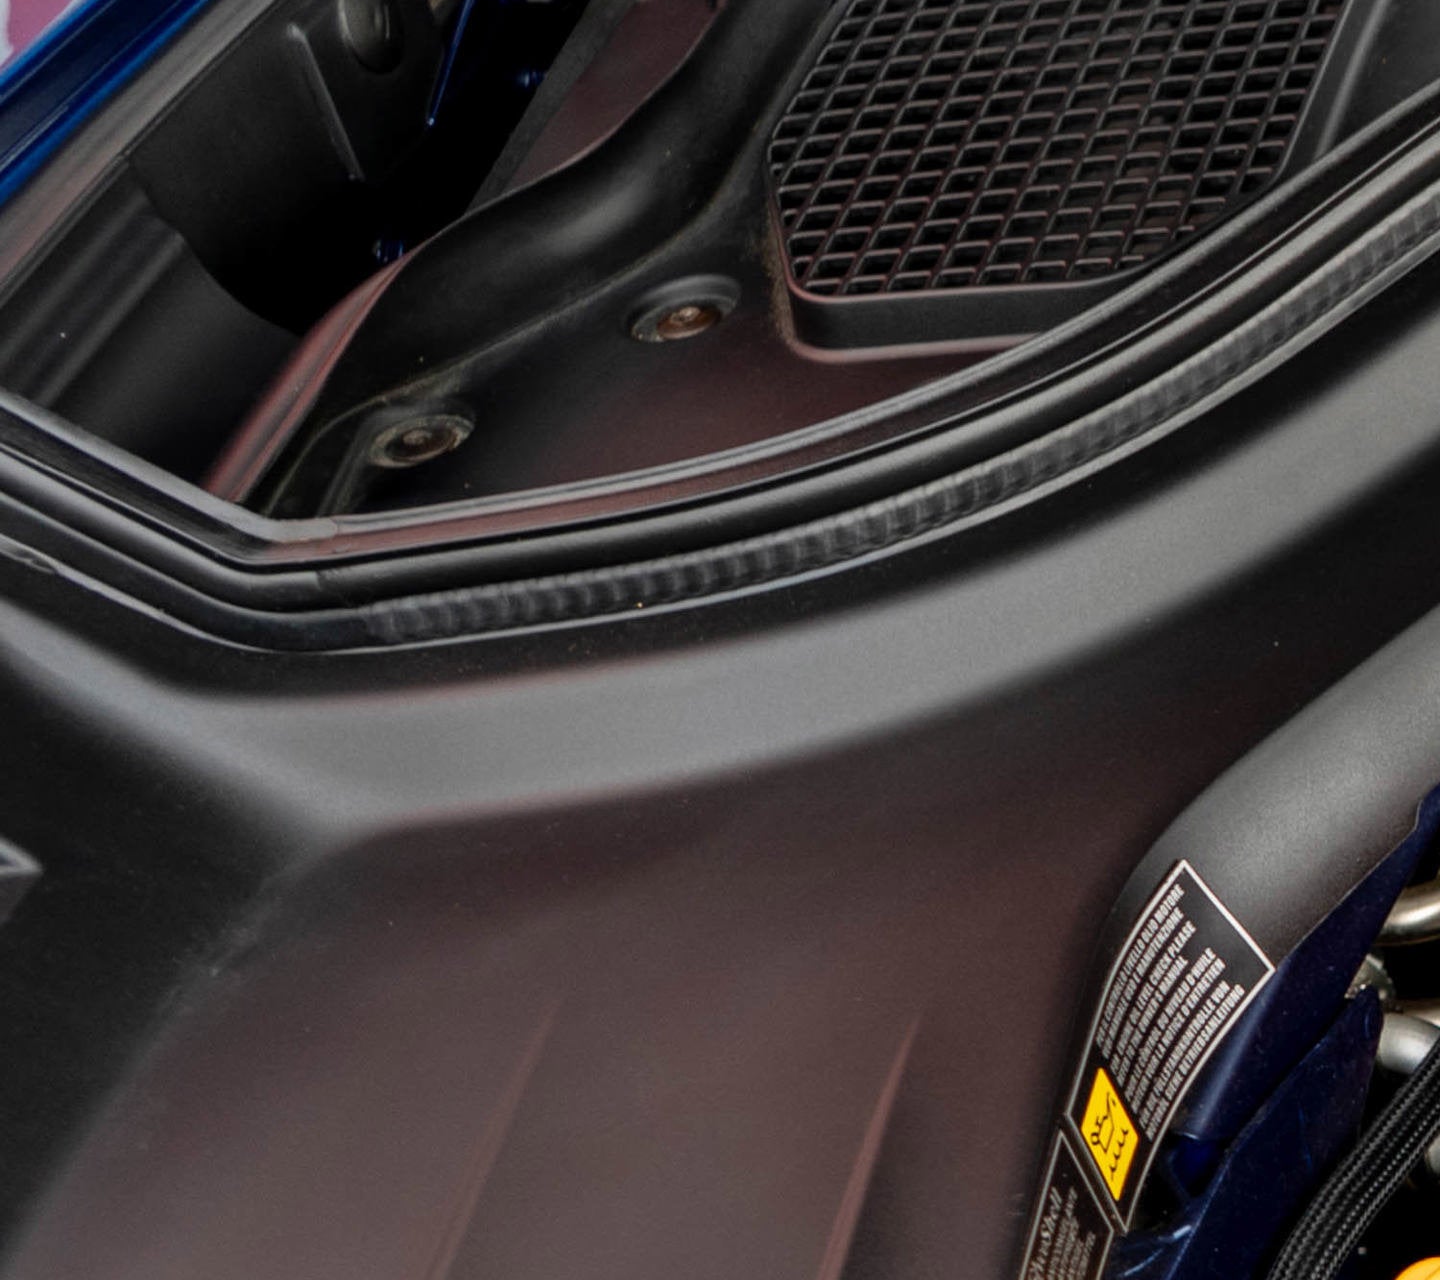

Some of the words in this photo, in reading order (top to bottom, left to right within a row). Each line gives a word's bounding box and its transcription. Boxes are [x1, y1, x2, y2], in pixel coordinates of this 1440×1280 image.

[1103, 969, 1128, 1021] CONTROLLO
[1121, 937, 1147, 975] LIVELLO
[1140, 917, 1159, 943] OLIO
[1152, 882, 1186, 923] MOTORE
[1107, 995, 1128, 1040] MANUALE
[1124, 977, 1138, 1001] USO
[1135, 906, 1185, 977] MANUTENZIONE
[1148, 951, 1173, 986] CHECK
[1165, 919, 1197, 958] PLEASE
[1116, 1055, 1131, 1088] REFER
[1130, 1028, 1143, 1048] THE
[1138, 989, 1165, 1033] OWNER'S
[1157, 954, 1188, 996] MANUAL
[1128, 1006, 1141, 1025] OIL
[1134, 981, 1155, 1011] LEVEL
[1163, 979, 1191, 1018] NIVEAU
[1115, 1019, 1136, 1056] ENGINE
[1129, 1074, 1151, 1114] MOTEUR
[1144, 1054, 1160, 1078] VOIR
[1160, 1011, 1186, 1047] NOTICE
[1145, 1090, 1159, 1112] DIE
[1210, 979, 1230, 1003] VON
[1164, 1068, 1184, 1100] SIEHE
[1178, 982, 1245, 1075] BETRIEBSANLEITUNG
